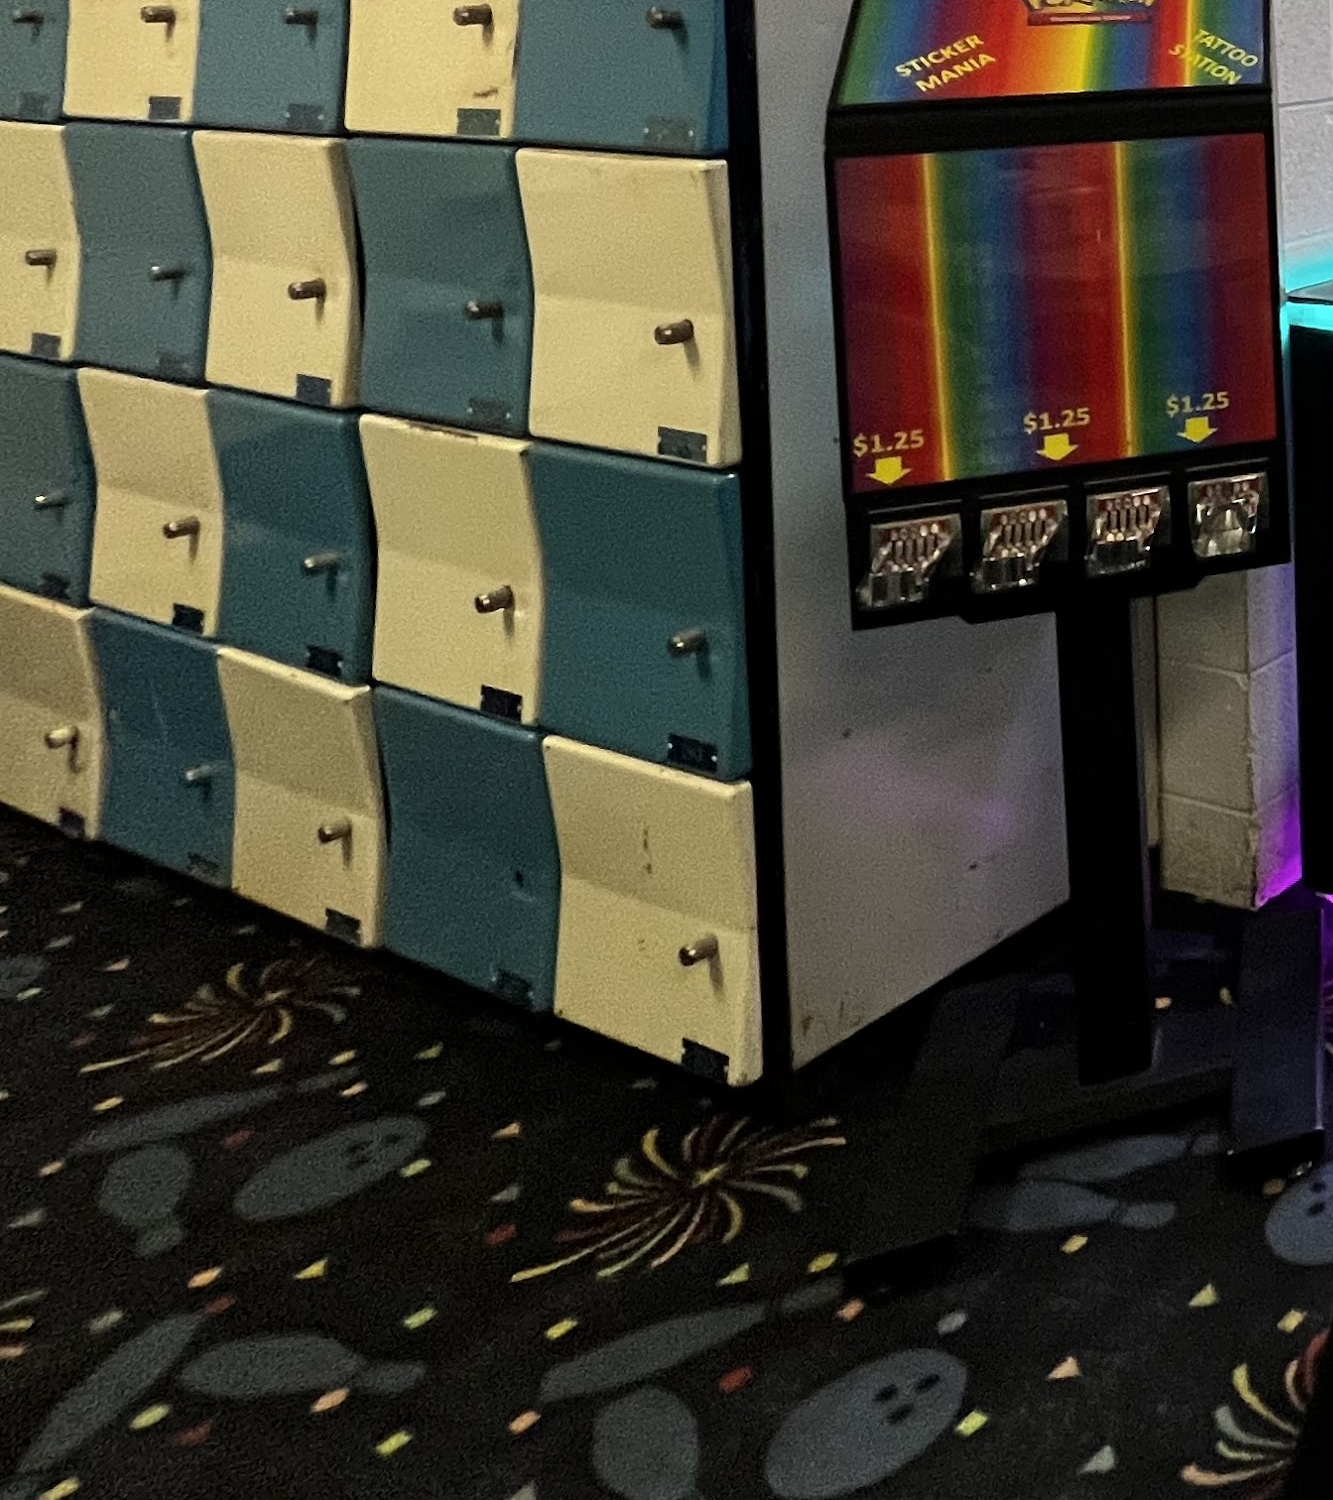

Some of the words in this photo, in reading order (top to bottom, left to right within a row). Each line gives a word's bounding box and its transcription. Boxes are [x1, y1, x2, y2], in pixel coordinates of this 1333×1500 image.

[895, 34, 984, 78] STICKER
[1169, 43, 1243, 86] STATION
[1194, 29, 1258, 68] TATTOO
[916, 52, 996, 93] MANIA
[1023, 407, 1090, 434] $1.25
[1166, 392, 1230, 417] $1.25
[853, 429, 925, 457] $1.25
